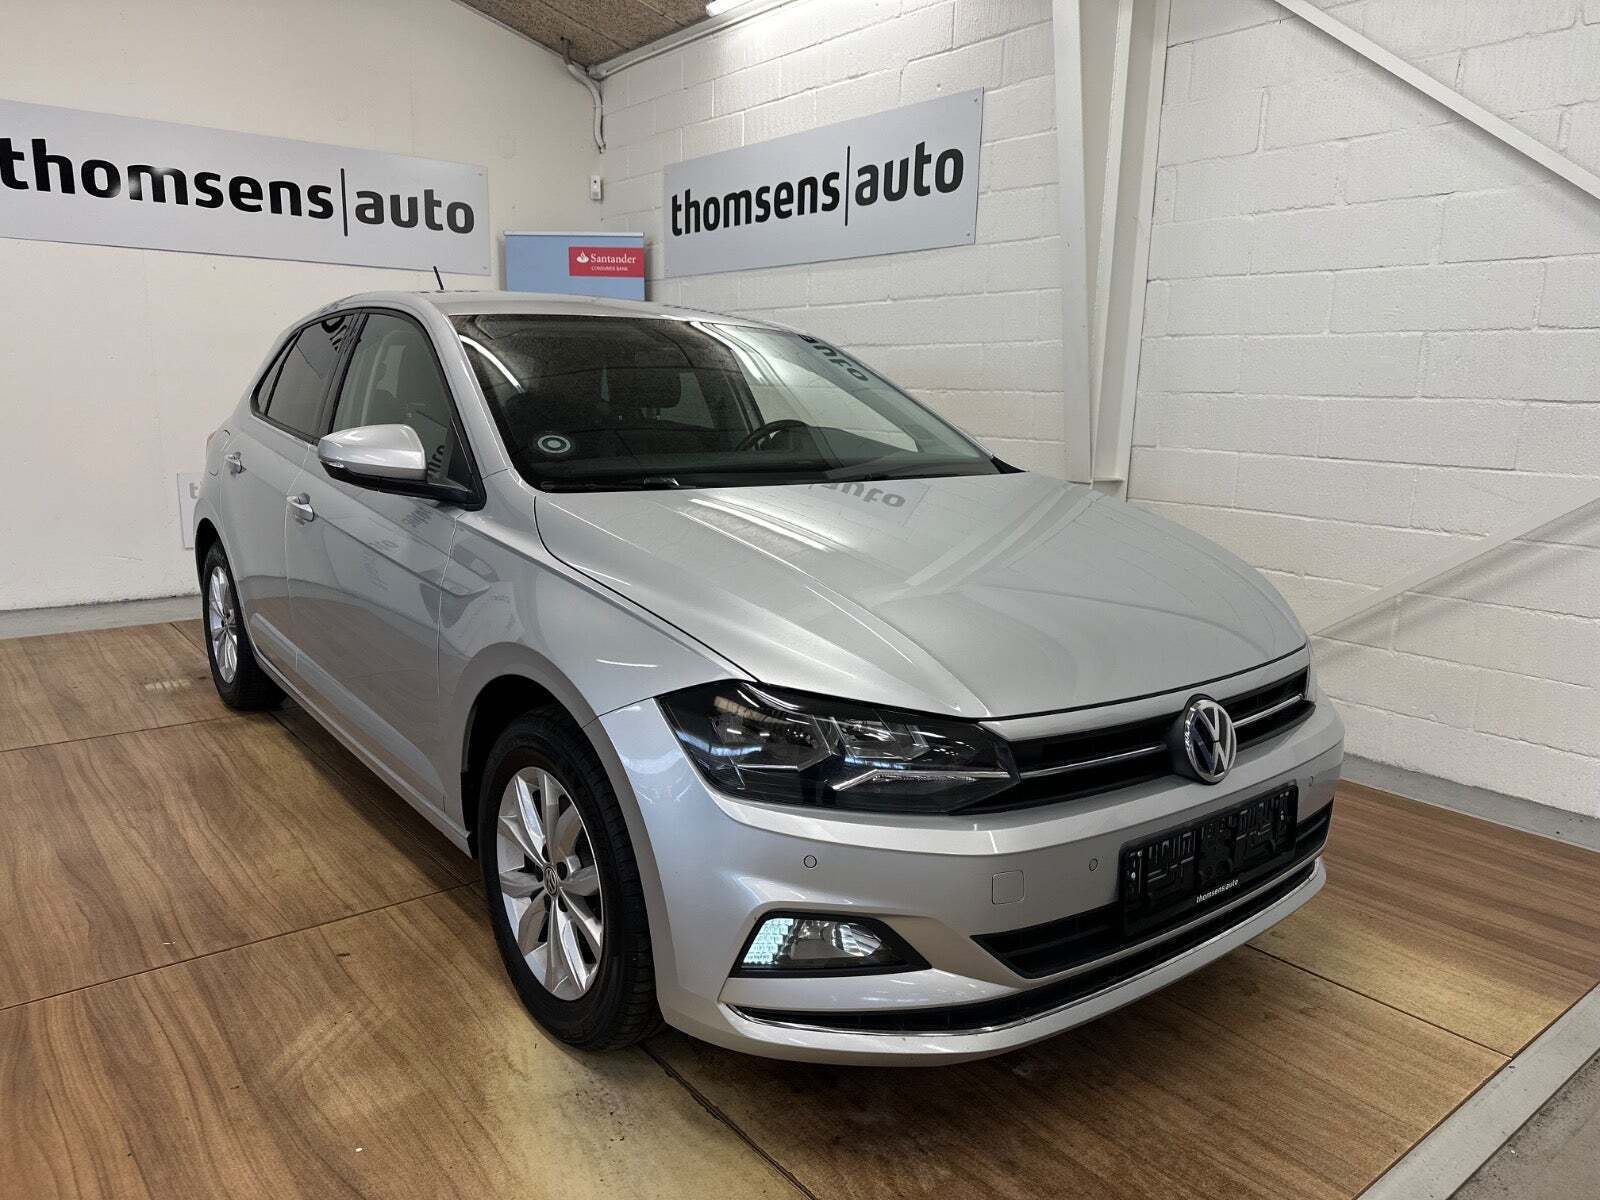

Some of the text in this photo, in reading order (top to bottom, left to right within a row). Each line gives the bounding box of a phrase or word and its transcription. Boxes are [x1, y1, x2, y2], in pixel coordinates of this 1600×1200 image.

[0, 137, 475, 235] thomsens auto
[671, 141, 965, 237] thomsens auto
[590, 253, 637, 264] Santander
